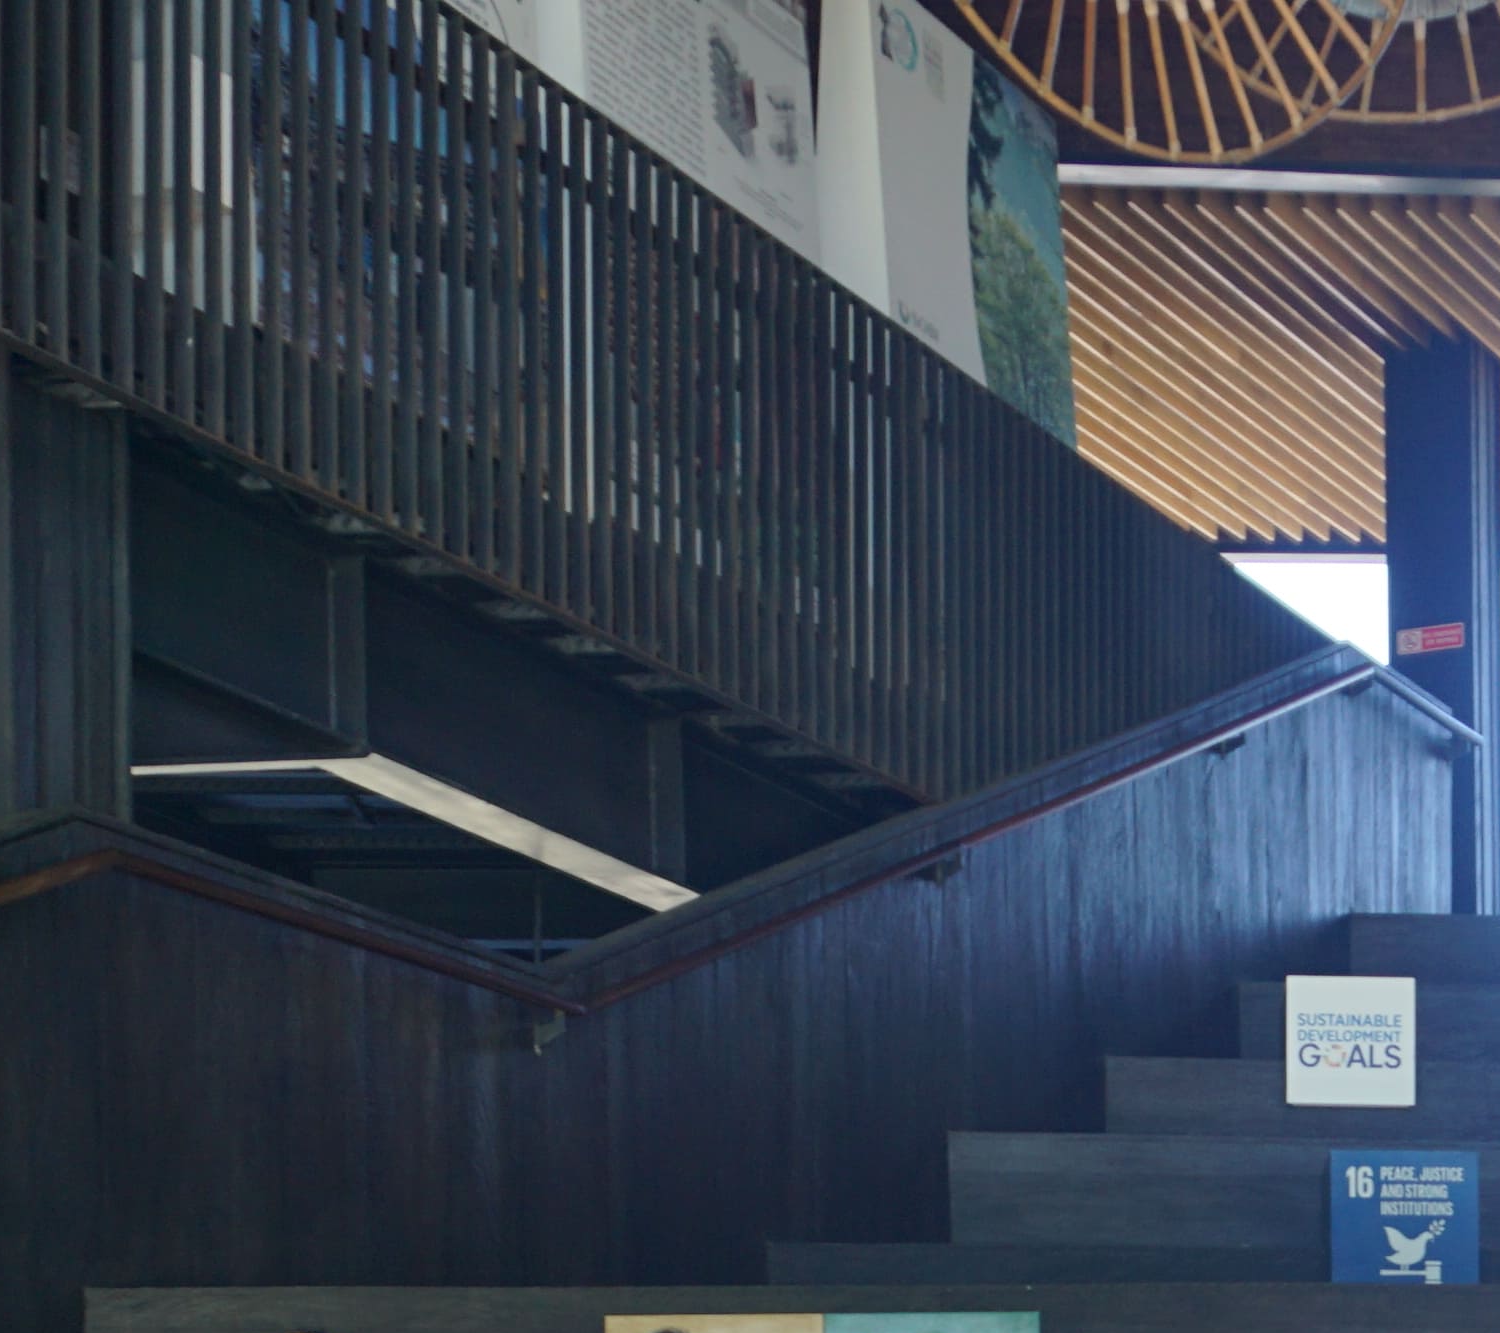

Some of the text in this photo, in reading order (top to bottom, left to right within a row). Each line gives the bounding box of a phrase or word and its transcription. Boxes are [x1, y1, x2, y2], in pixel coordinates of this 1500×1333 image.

[1297, 1013, 1402, 1027] SUSTAINABLE
[1297, 1030, 1401, 1042] DEVELOPMENT
[1298, 1043, 1401, 1069] GOALS
[1380, 1166, 1464, 1182] PEACE, JUSTICE
[1346, 1166, 1374, 1198] 16
[1380, 1184, 1448, 1198] AND STRONG
[1380, 1201, 1453, 1215] INSTITUTIONS
